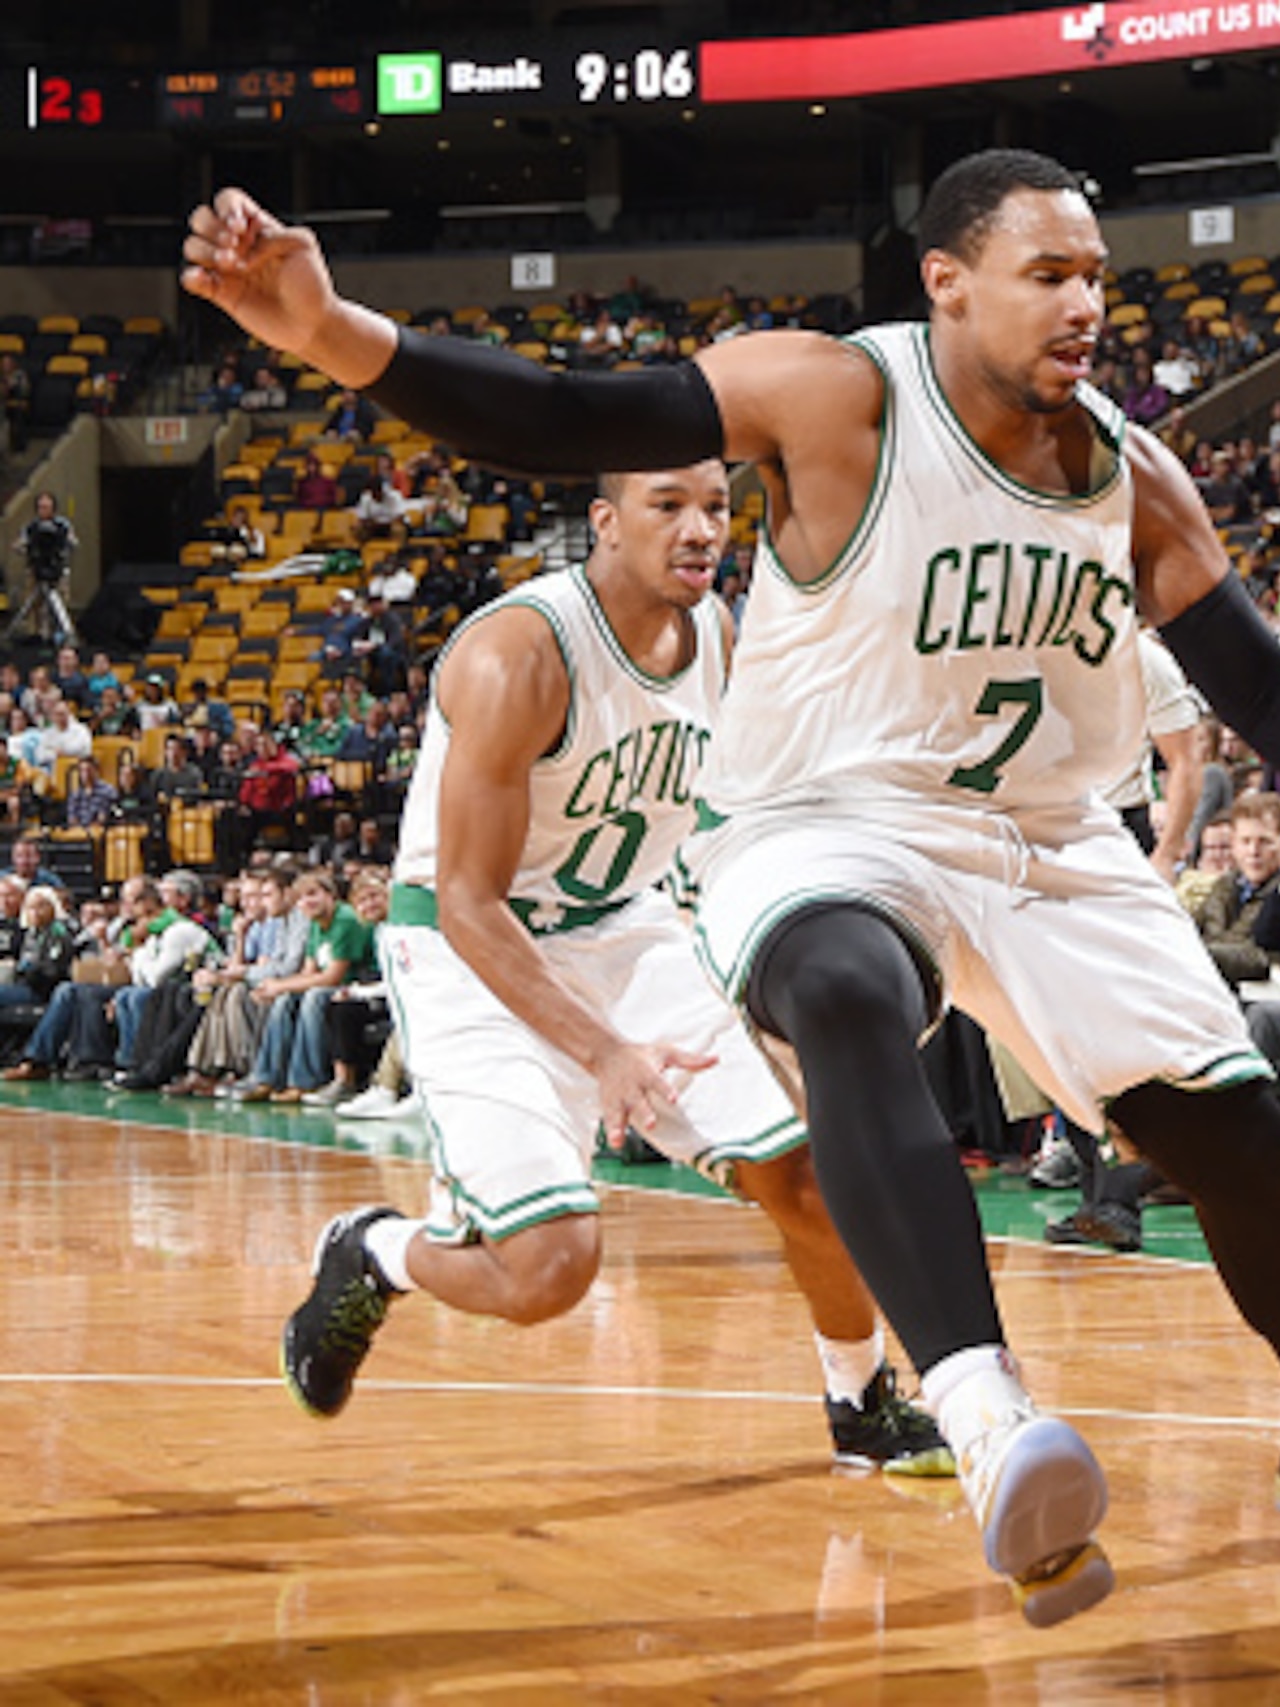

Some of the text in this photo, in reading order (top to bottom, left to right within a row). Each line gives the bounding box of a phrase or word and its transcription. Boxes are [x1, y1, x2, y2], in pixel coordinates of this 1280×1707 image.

[1120, 7, 1212, 44] COUNT
[1218, 3, 1251, 32] US
[384, 63, 434, 101] TD
[449, 58, 541, 93] Bank
[575, 50, 693, 101] 9:06
[1202, 214, 1217, 238] 9
[525, 258, 540, 284] 8
[915, 541, 1131, 668] CELTICS
[946, 676, 1043, 793] 7
[552, 810, 648, 902] 0
